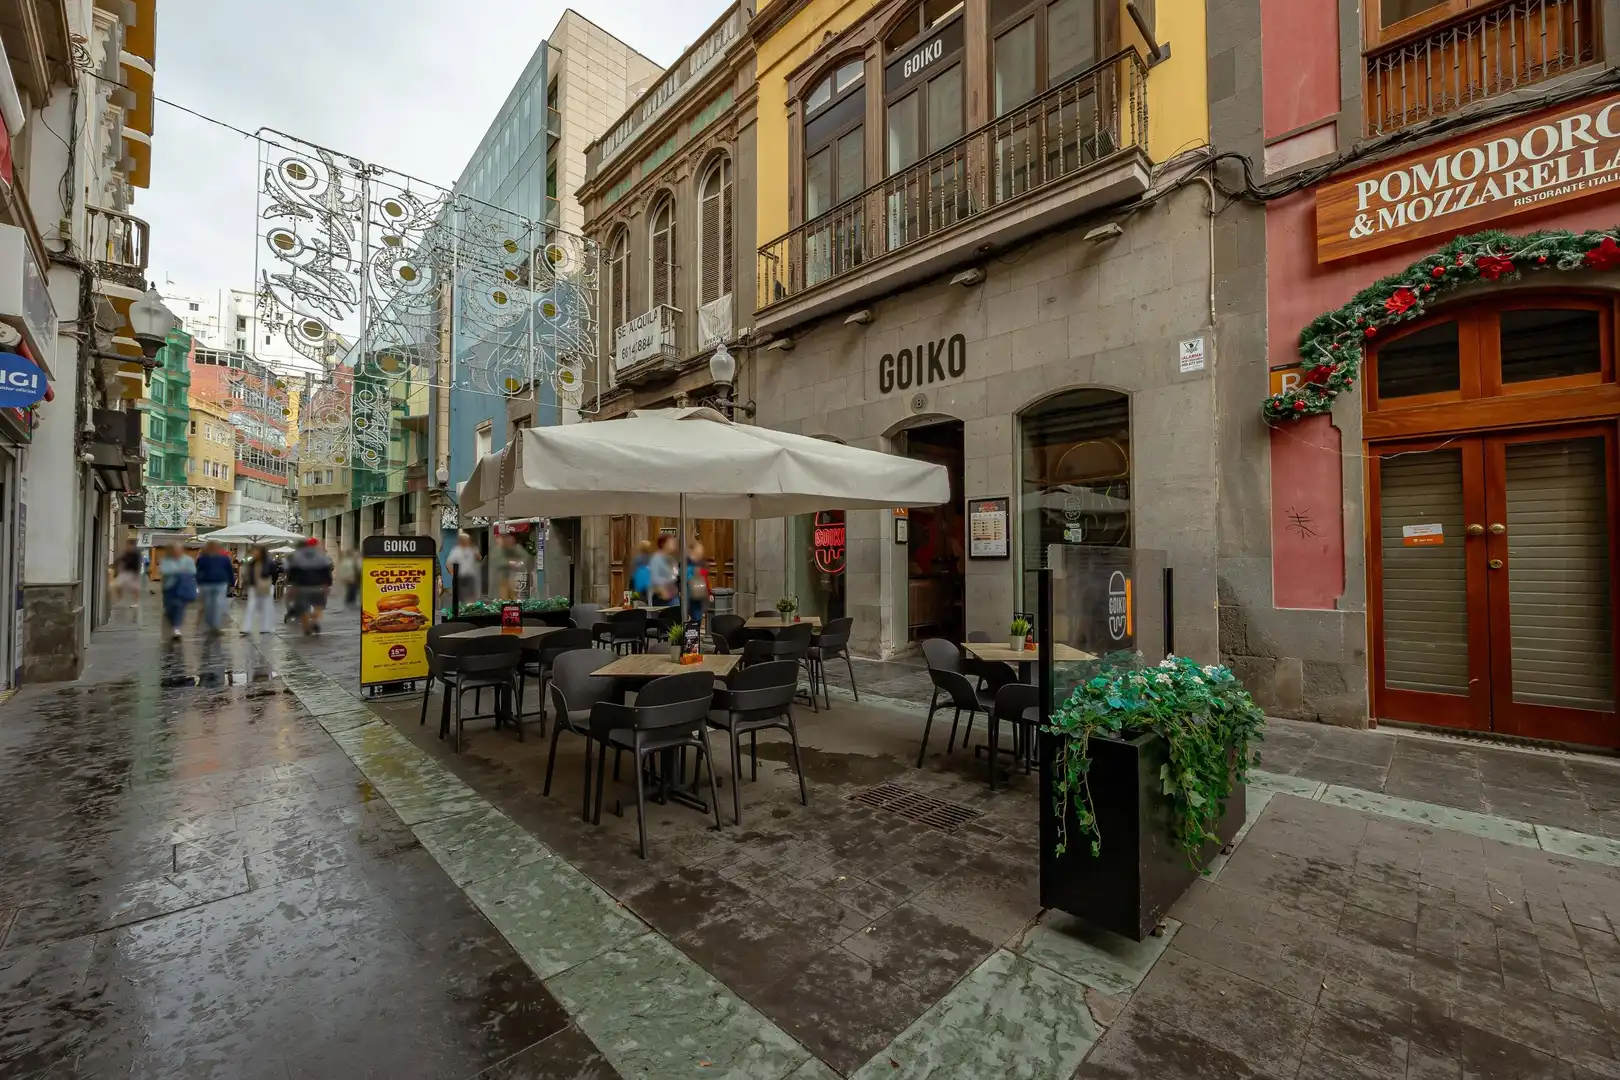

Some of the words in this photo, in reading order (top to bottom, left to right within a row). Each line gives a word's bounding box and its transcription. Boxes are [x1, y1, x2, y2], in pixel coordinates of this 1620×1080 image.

[904, 39, 942, 78] GOIKO
[1355, 102, 1620, 211] POMODORO
[1514, 183, 1585, 206] RISTORANTE
[1588, 172, 1620, 187] ITALI
[617, 325, 626, 339] SE
[629, 309, 658, 334] ALQUILA
[879, 333, 966, 394] GOIKO
[384, 540, 416, 552] GOIKO
[369, 569, 426, 577] GOLDEN
[375, 576, 421, 584] GLAZE
[380, 582, 416, 593] donuts
[1109, 597, 1126, 614] GOIKO
